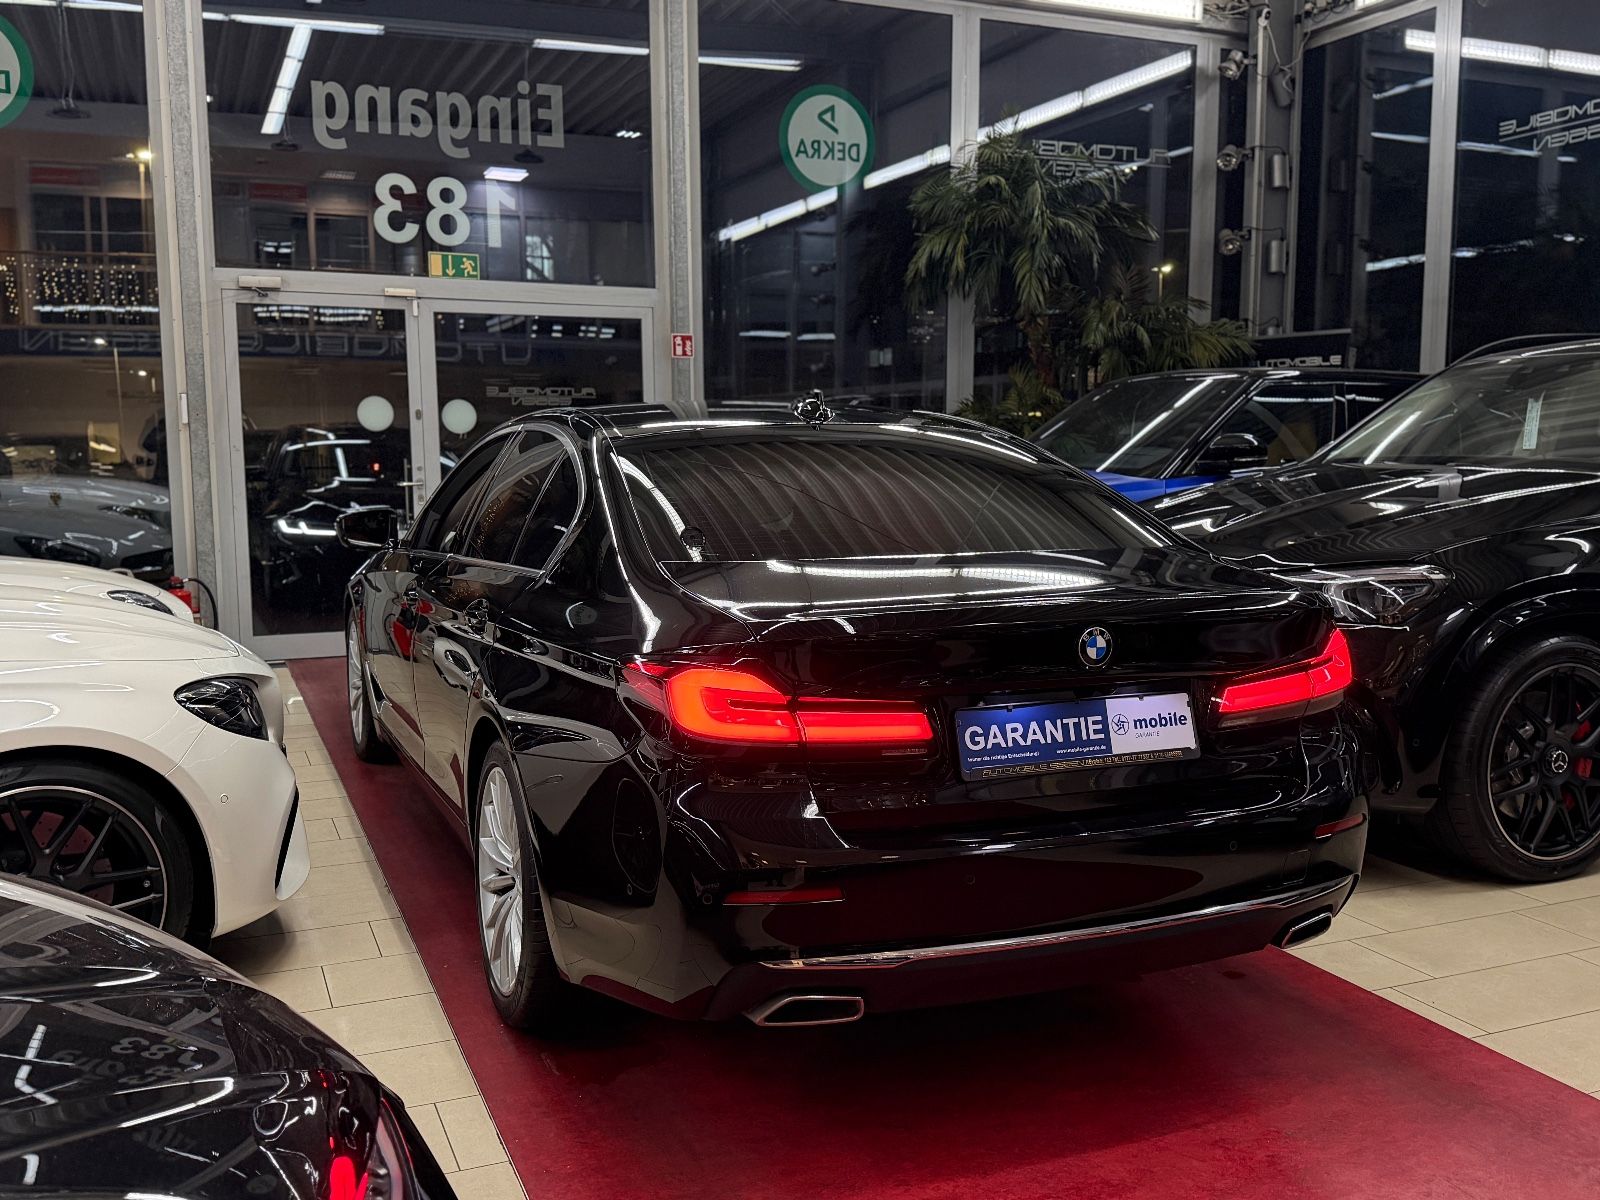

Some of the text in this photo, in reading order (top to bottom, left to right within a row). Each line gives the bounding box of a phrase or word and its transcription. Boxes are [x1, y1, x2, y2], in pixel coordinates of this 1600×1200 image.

[1133, 712, 1187, 729] mobile
[964, 715, 1105, 751] GARANTIE
[1135, 731, 1160, 739] GARANTIE
